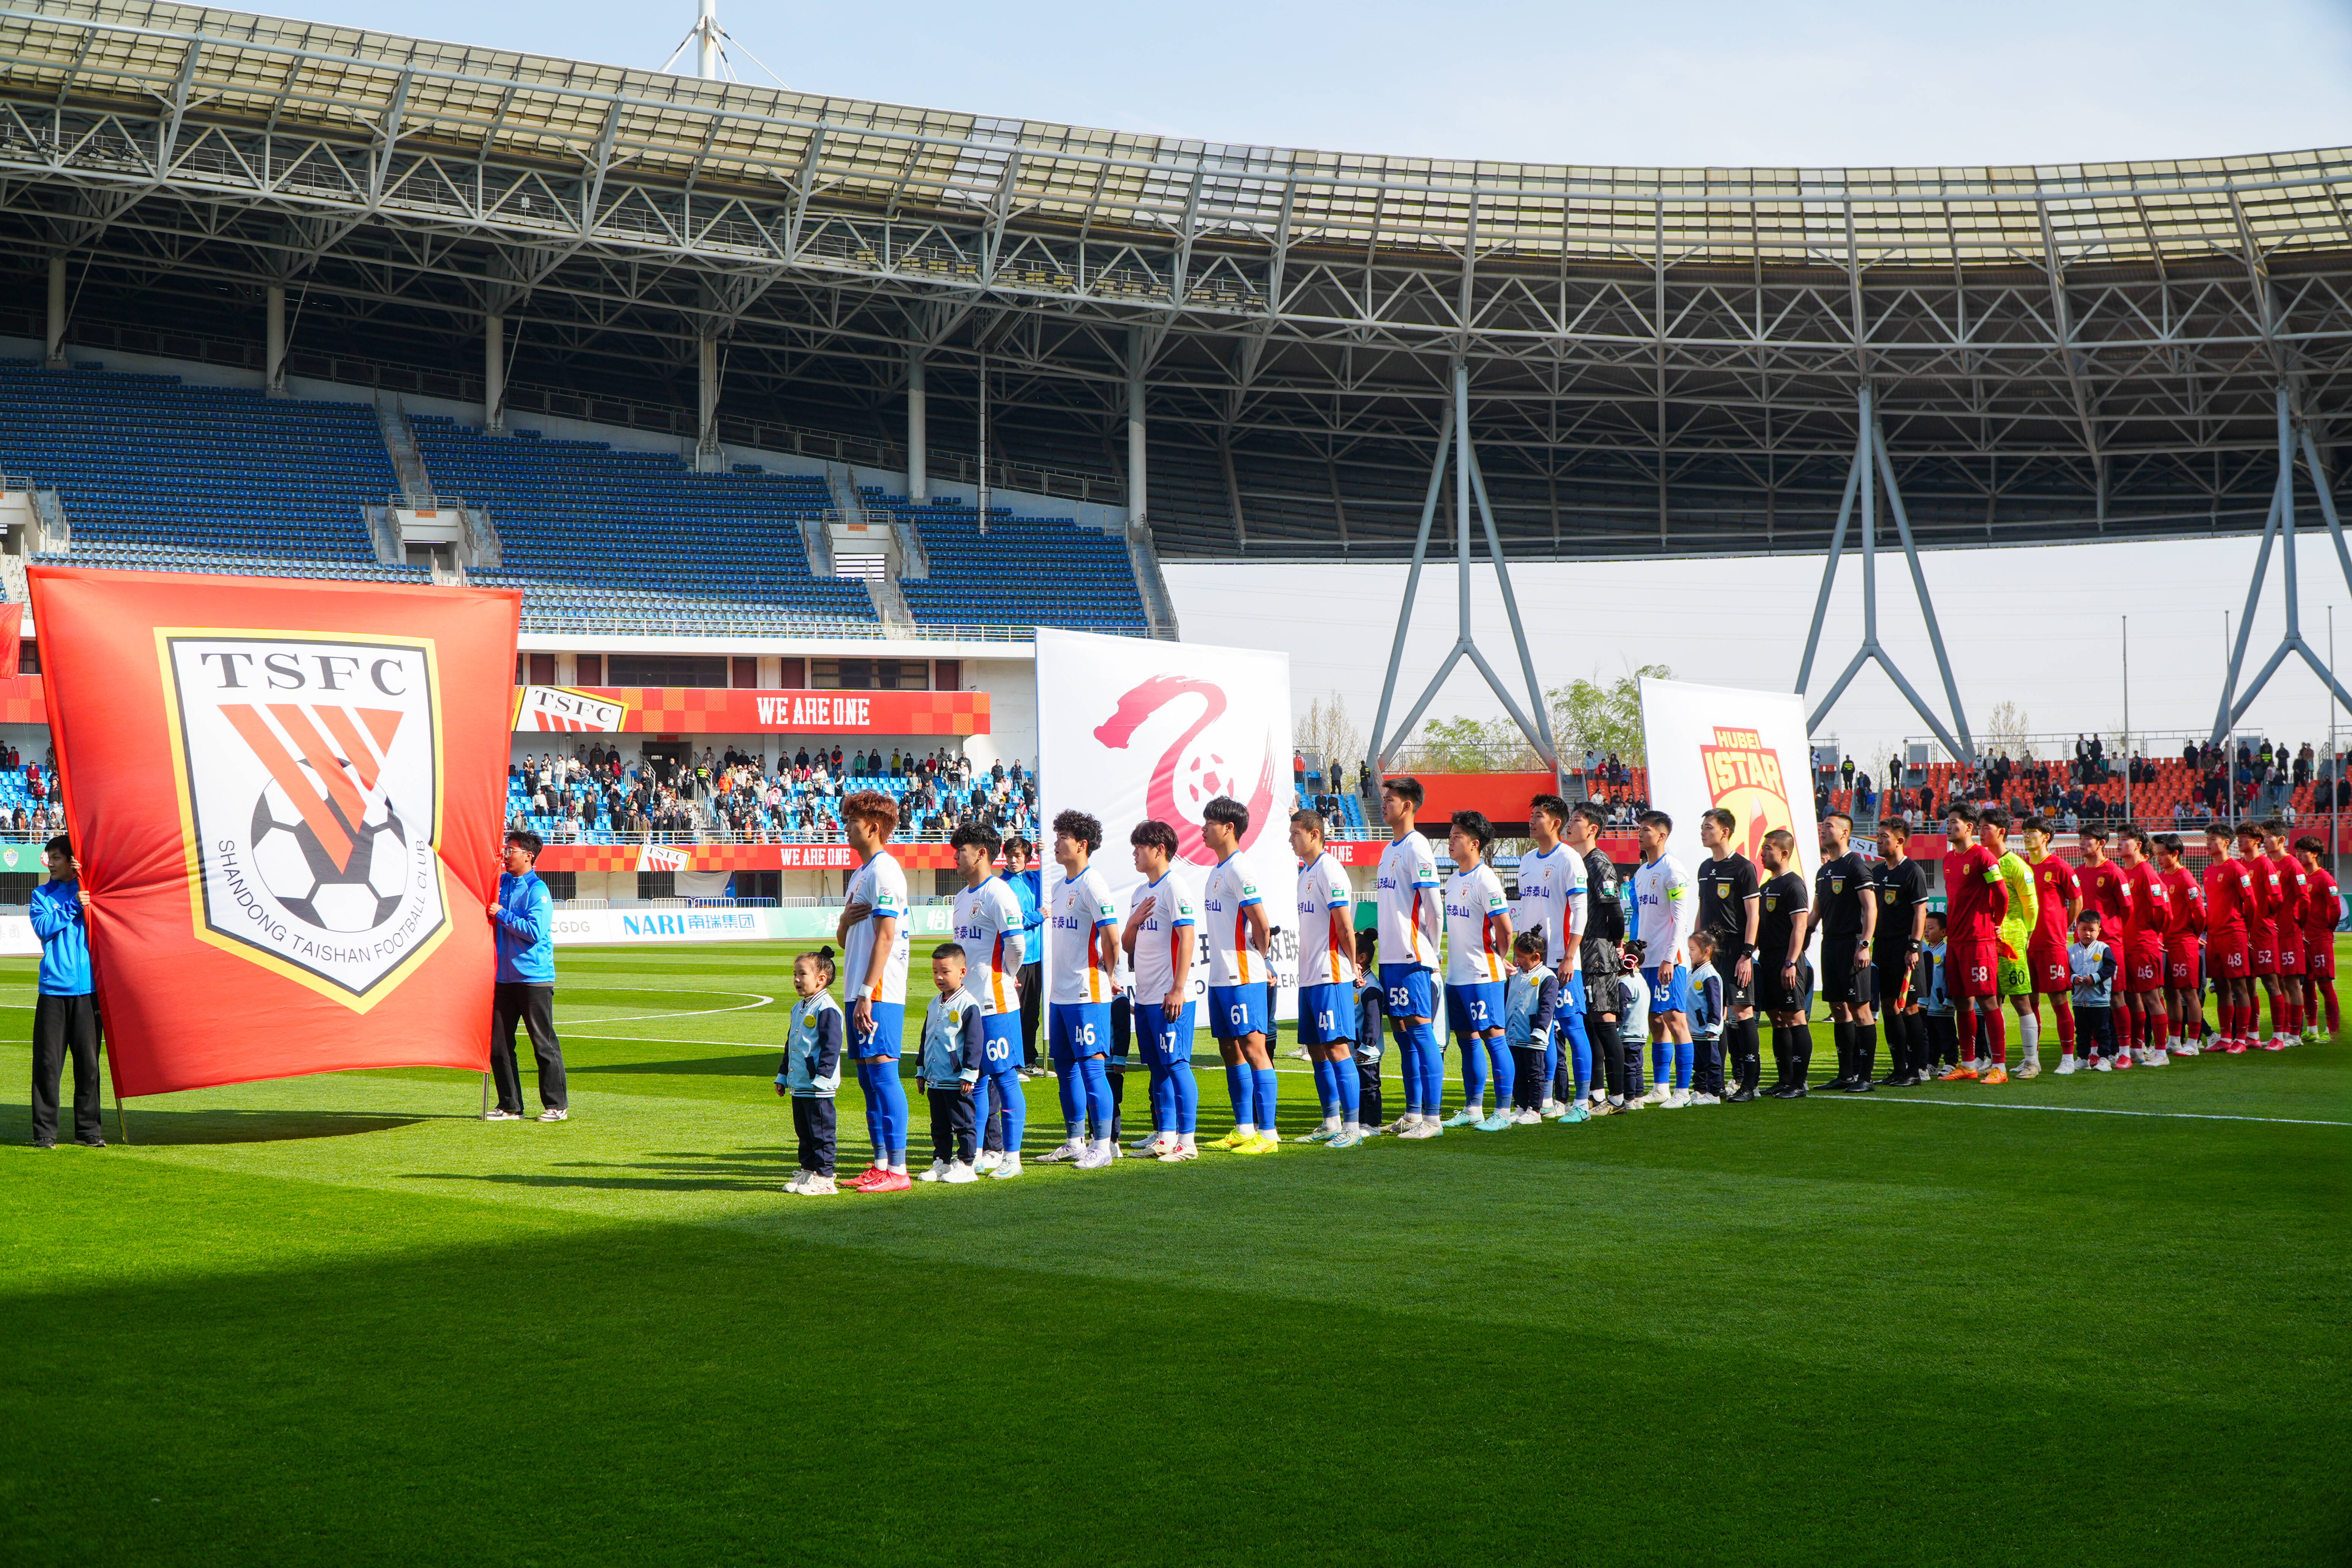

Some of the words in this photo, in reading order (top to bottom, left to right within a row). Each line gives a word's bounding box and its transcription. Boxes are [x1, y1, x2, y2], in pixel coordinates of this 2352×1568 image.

[201, 653, 406, 696] TSFC
[535, 690, 612, 722] TSFC
[757, 697, 788, 724] WE
[792, 698, 828, 724] ARE
[833, 698, 870, 725] ONE
[1715, 730, 1761, 749] HUBEI
[1704, 751, 1786, 800] ISTAR
[646, 847, 684, 862] TSFC
[1848, 838, 1878, 852] TSF
[781, 849, 800, 866] WE
[802, 848, 826, 865] ARE
[827, 848, 850, 865] ONE
[219, 840, 286, 942] SHANDONG
[292, 934, 371, 963] TAISHAN
[374, 896, 425, 959] FOOTBALL
[416, 840, 427, 889] CLUB
[623, 914, 685, 935] NARI
[688, 914, 755, 929] 南瑞集团
[2227, 953, 2241, 967] 48
[2258, 950, 2271, 963] 52
[2282, 952, 2295, 965] 55
[2314, 954, 2325, 967] 51
[1971, 966, 1988, 982] 58
[2009, 971, 2025, 985] 60
[2050, 964, 2065, 980] 54
[2138, 965, 2153, 979] 46
[2173, 963, 2187, 977] 56
[1389, 988, 1409, 1007] 58
[1555, 989, 1574, 1008] 64
[1654, 984, 1670, 1002] 45
[1230, 1003, 1249, 1025] 61
[1318, 1010, 1336, 1031] 41
[1470, 1001, 1488, 1021] 62
[1075, 1023, 1096, 1046] 46
[1160, 1031, 1177, 1053] 47
[986, 1037, 1009, 1061] 60
